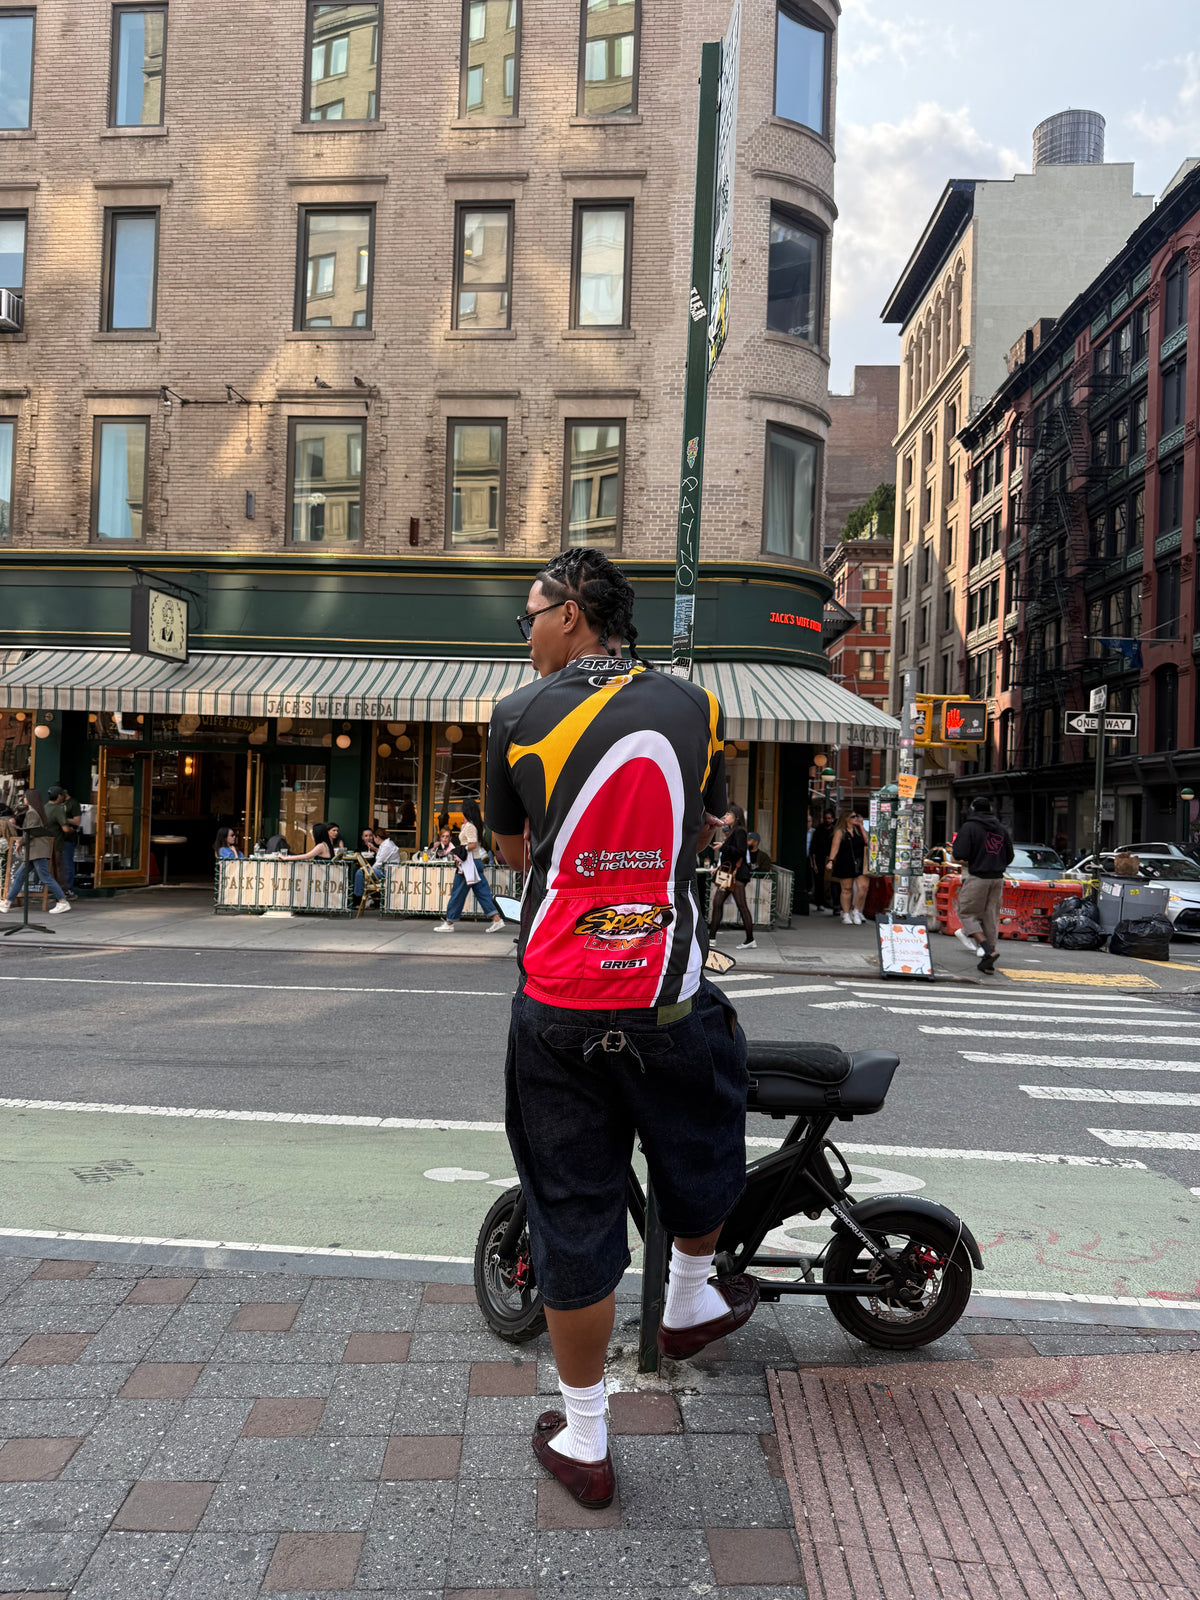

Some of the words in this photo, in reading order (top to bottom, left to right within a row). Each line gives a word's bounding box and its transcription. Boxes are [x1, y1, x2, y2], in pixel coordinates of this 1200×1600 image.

[769, 612, 795, 625] JACK'S
[577, 659, 633, 671] BRVST
[267, 700, 312, 715] JACK'S
[317, 702, 350, 716] WIFE
[354, 702, 393, 717] FREDA
[1076, 719, 1097, 728] ONE
[1105, 720, 1127, 729] WAY
[847, 727, 879, 743] JACK'S
[600, 848, 662, 861] bravest
[599, 857, 668, 871] network
[222, 875, 265, 891] JACK'S
[271, 878, 302, 892] WIFE
[307, 880, 345, 894] FREDA
[389, 881, 432, 895] JACK'S
[601, 958, 646, 969] BRVST
[831, 1204, 880, 1255] ROADRUNNER
